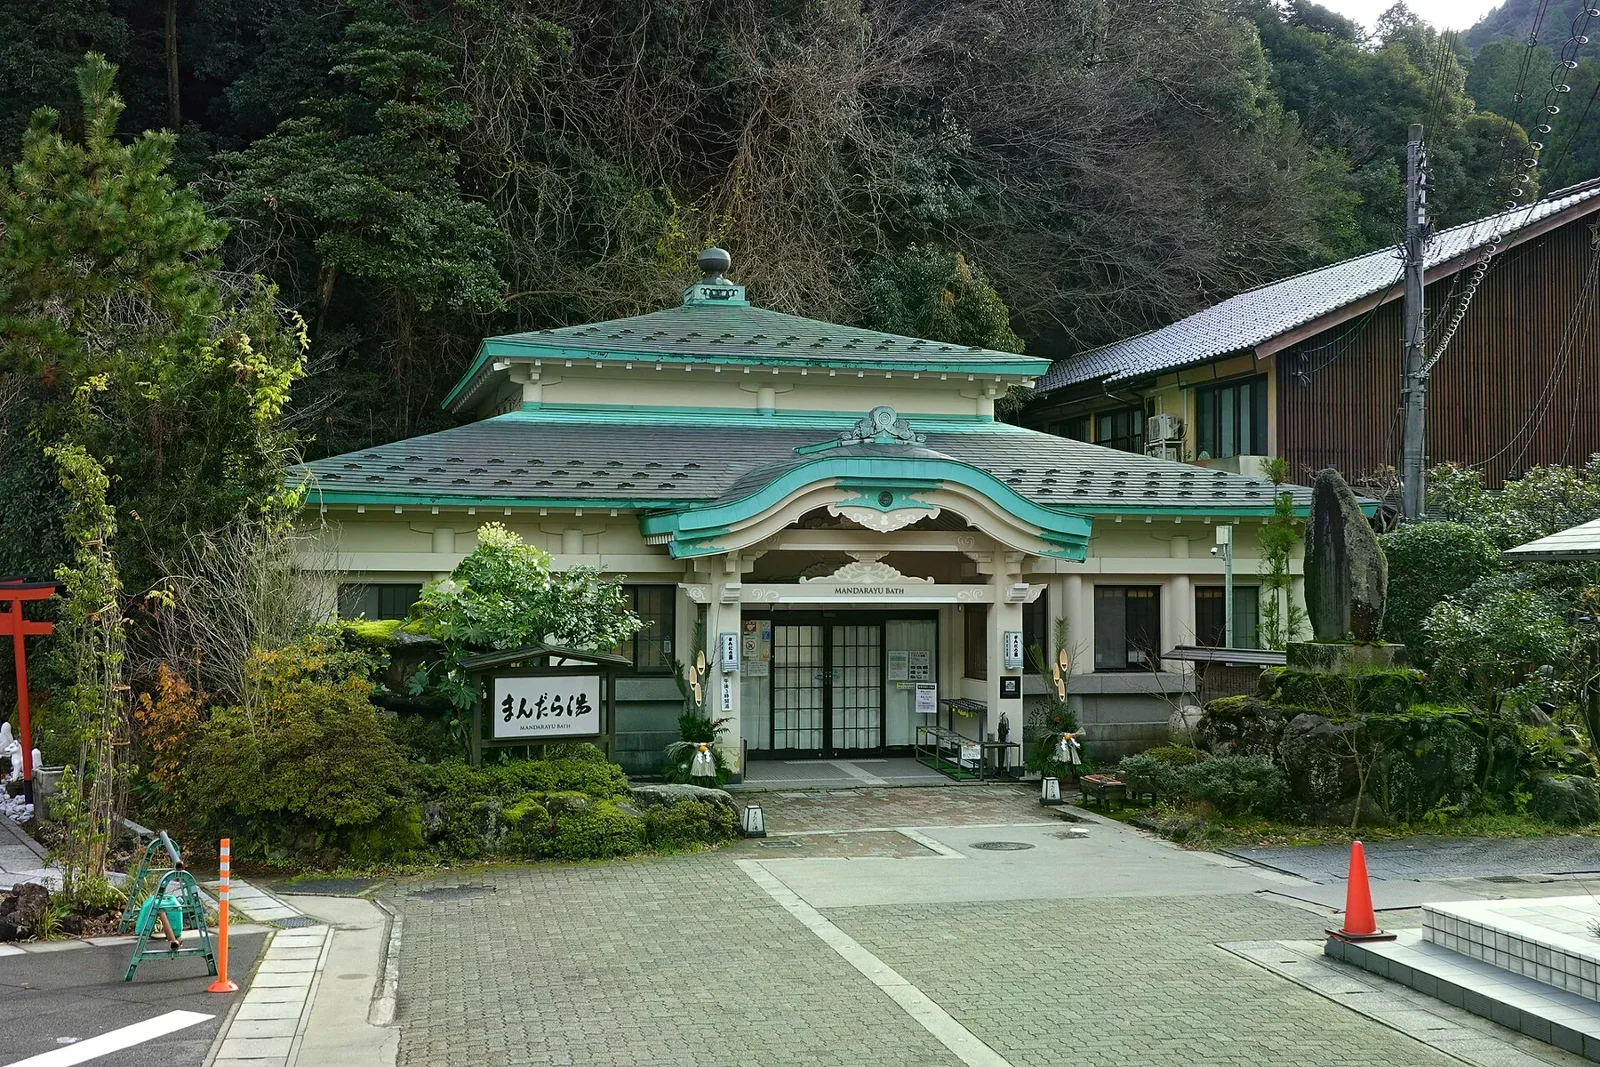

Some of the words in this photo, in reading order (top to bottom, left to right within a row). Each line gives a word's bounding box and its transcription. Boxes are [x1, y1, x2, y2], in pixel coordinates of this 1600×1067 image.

[834, 587, 884, 595] MANDARAYU
[885, 587, 905, 595] BATH
[501, 692, 592, 722] まんだら湯
